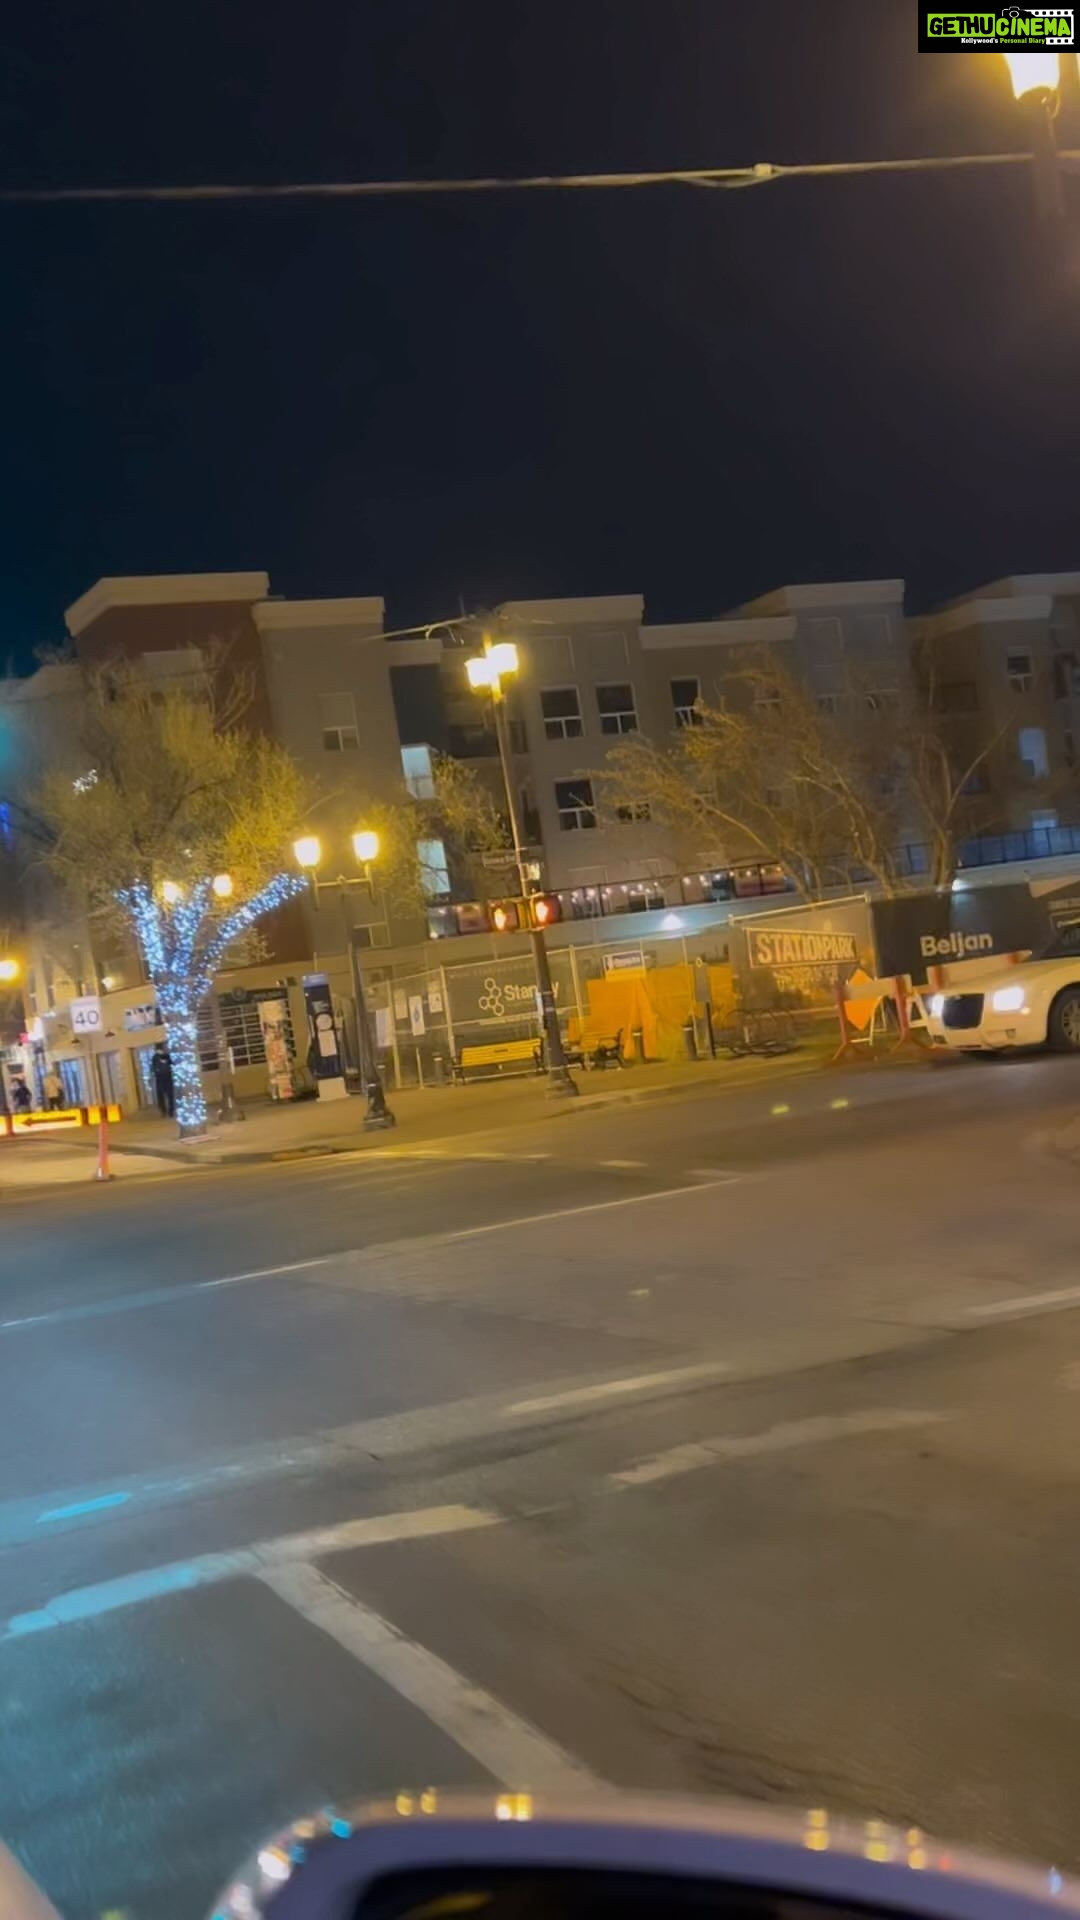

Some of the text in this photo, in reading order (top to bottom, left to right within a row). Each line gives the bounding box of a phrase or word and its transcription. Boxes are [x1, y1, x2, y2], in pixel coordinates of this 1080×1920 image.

[920, 932, 993, 958] Beljan
[503, 981, 559, 1001] Stany
[75, 1010, 99, 1024] 40
